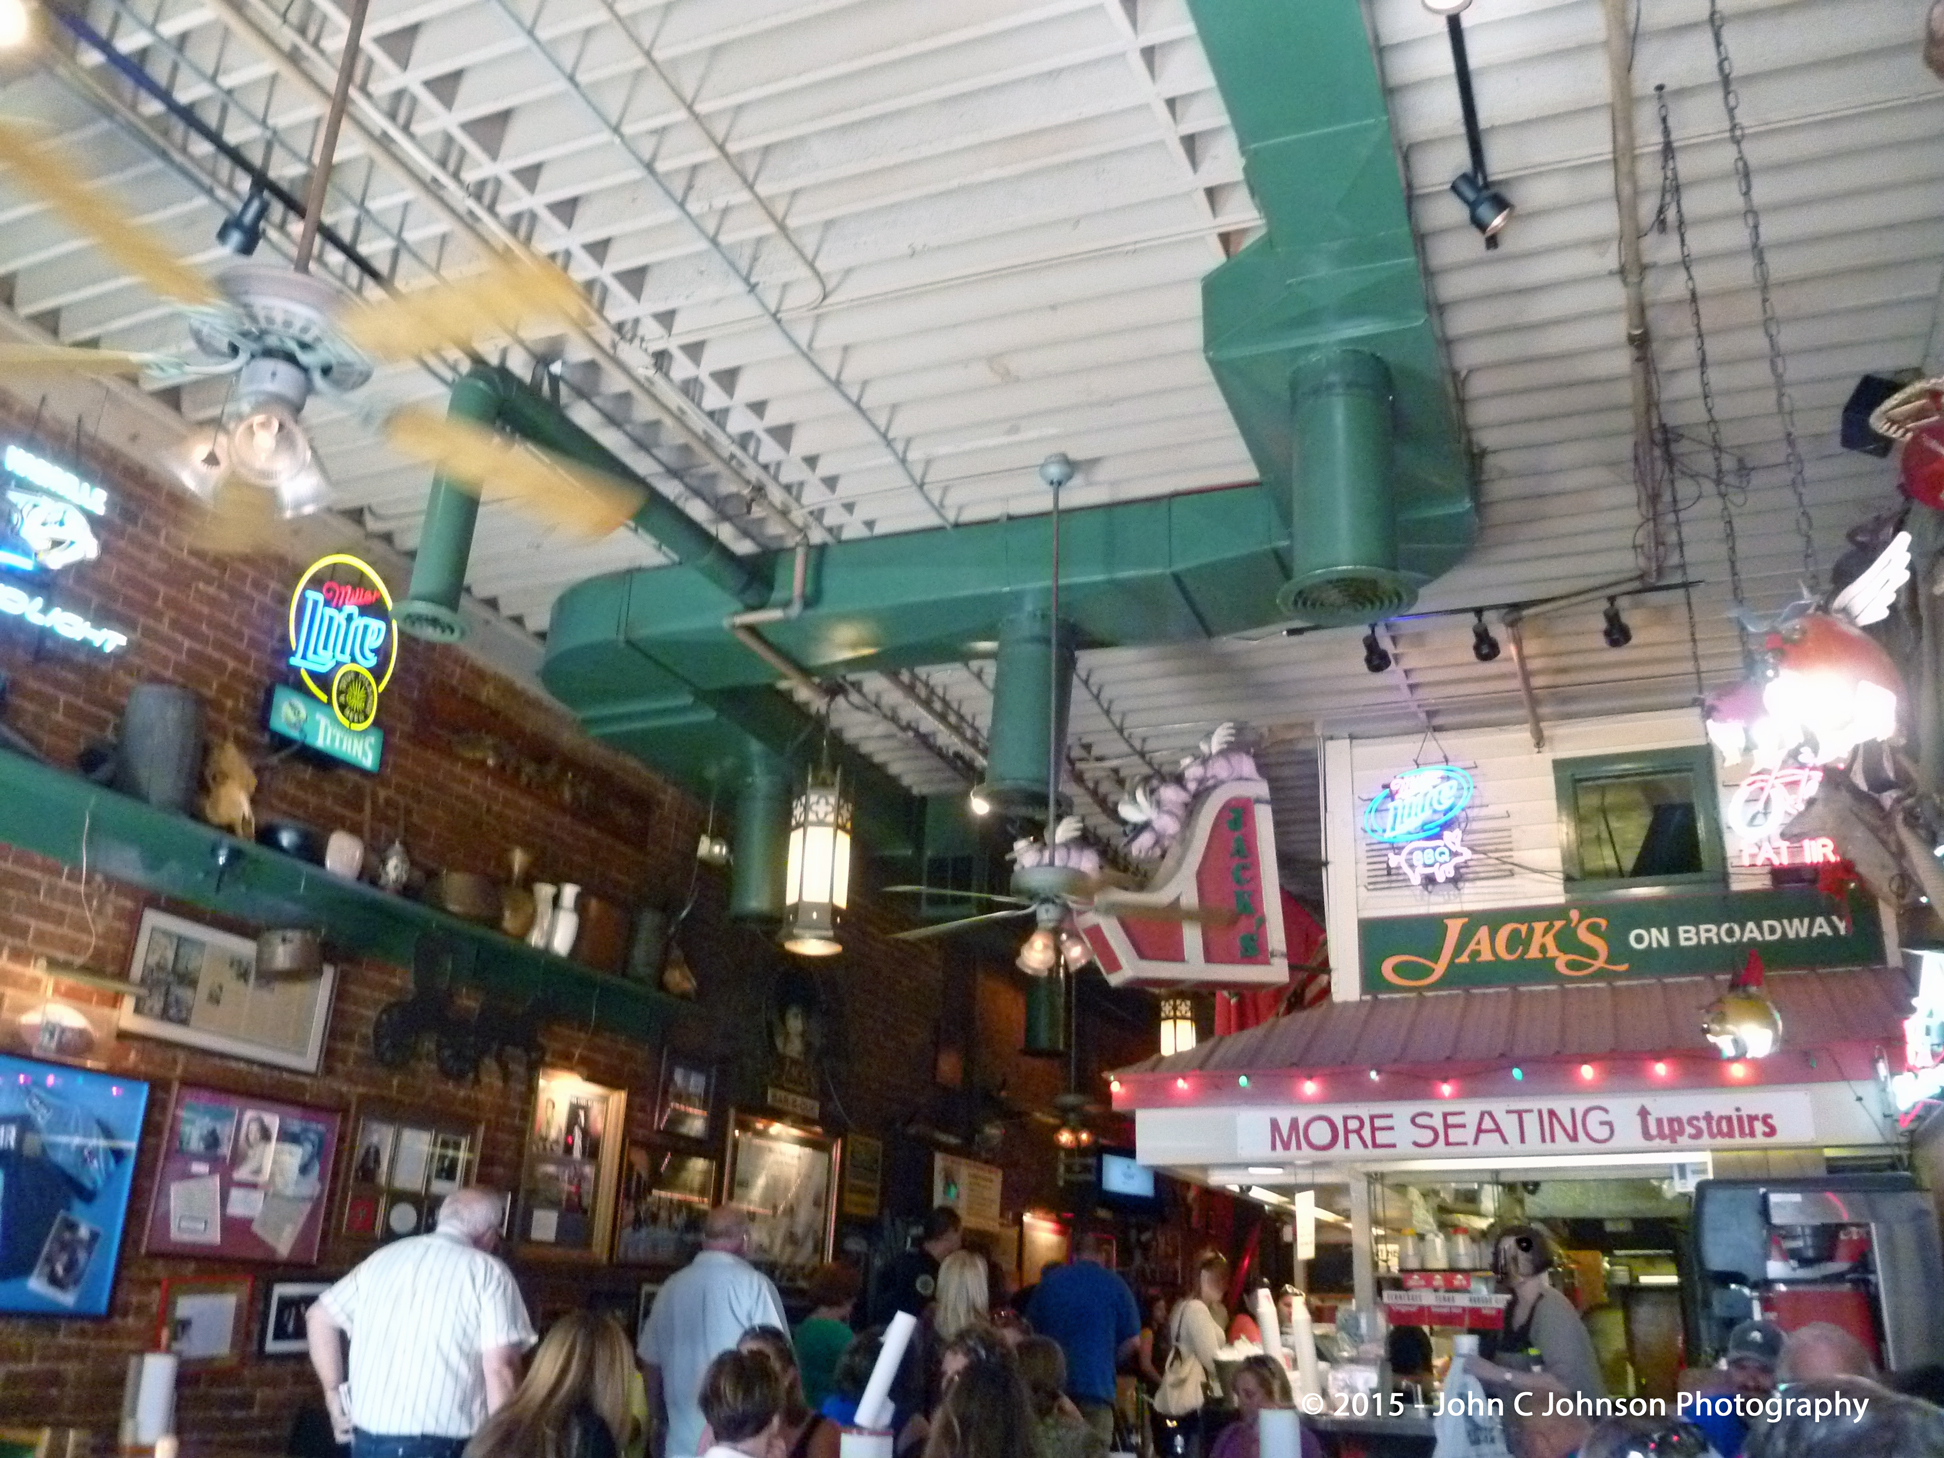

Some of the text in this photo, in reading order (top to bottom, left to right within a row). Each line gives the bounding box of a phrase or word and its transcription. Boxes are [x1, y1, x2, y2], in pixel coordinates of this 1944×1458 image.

[322, 580, 381, 608] Miller
[288, 589, 387, 673] Lite
[1226, 808, 1264, 958] JACK'S
[1412, 845, 1451, 866] BBQ
[1381, 908, 1848, 986] JACK'S ON BROADWAY
[1269, 1113, 1397, 1152] MORE
[1410, 1104, 1616, 1149] SEATING
